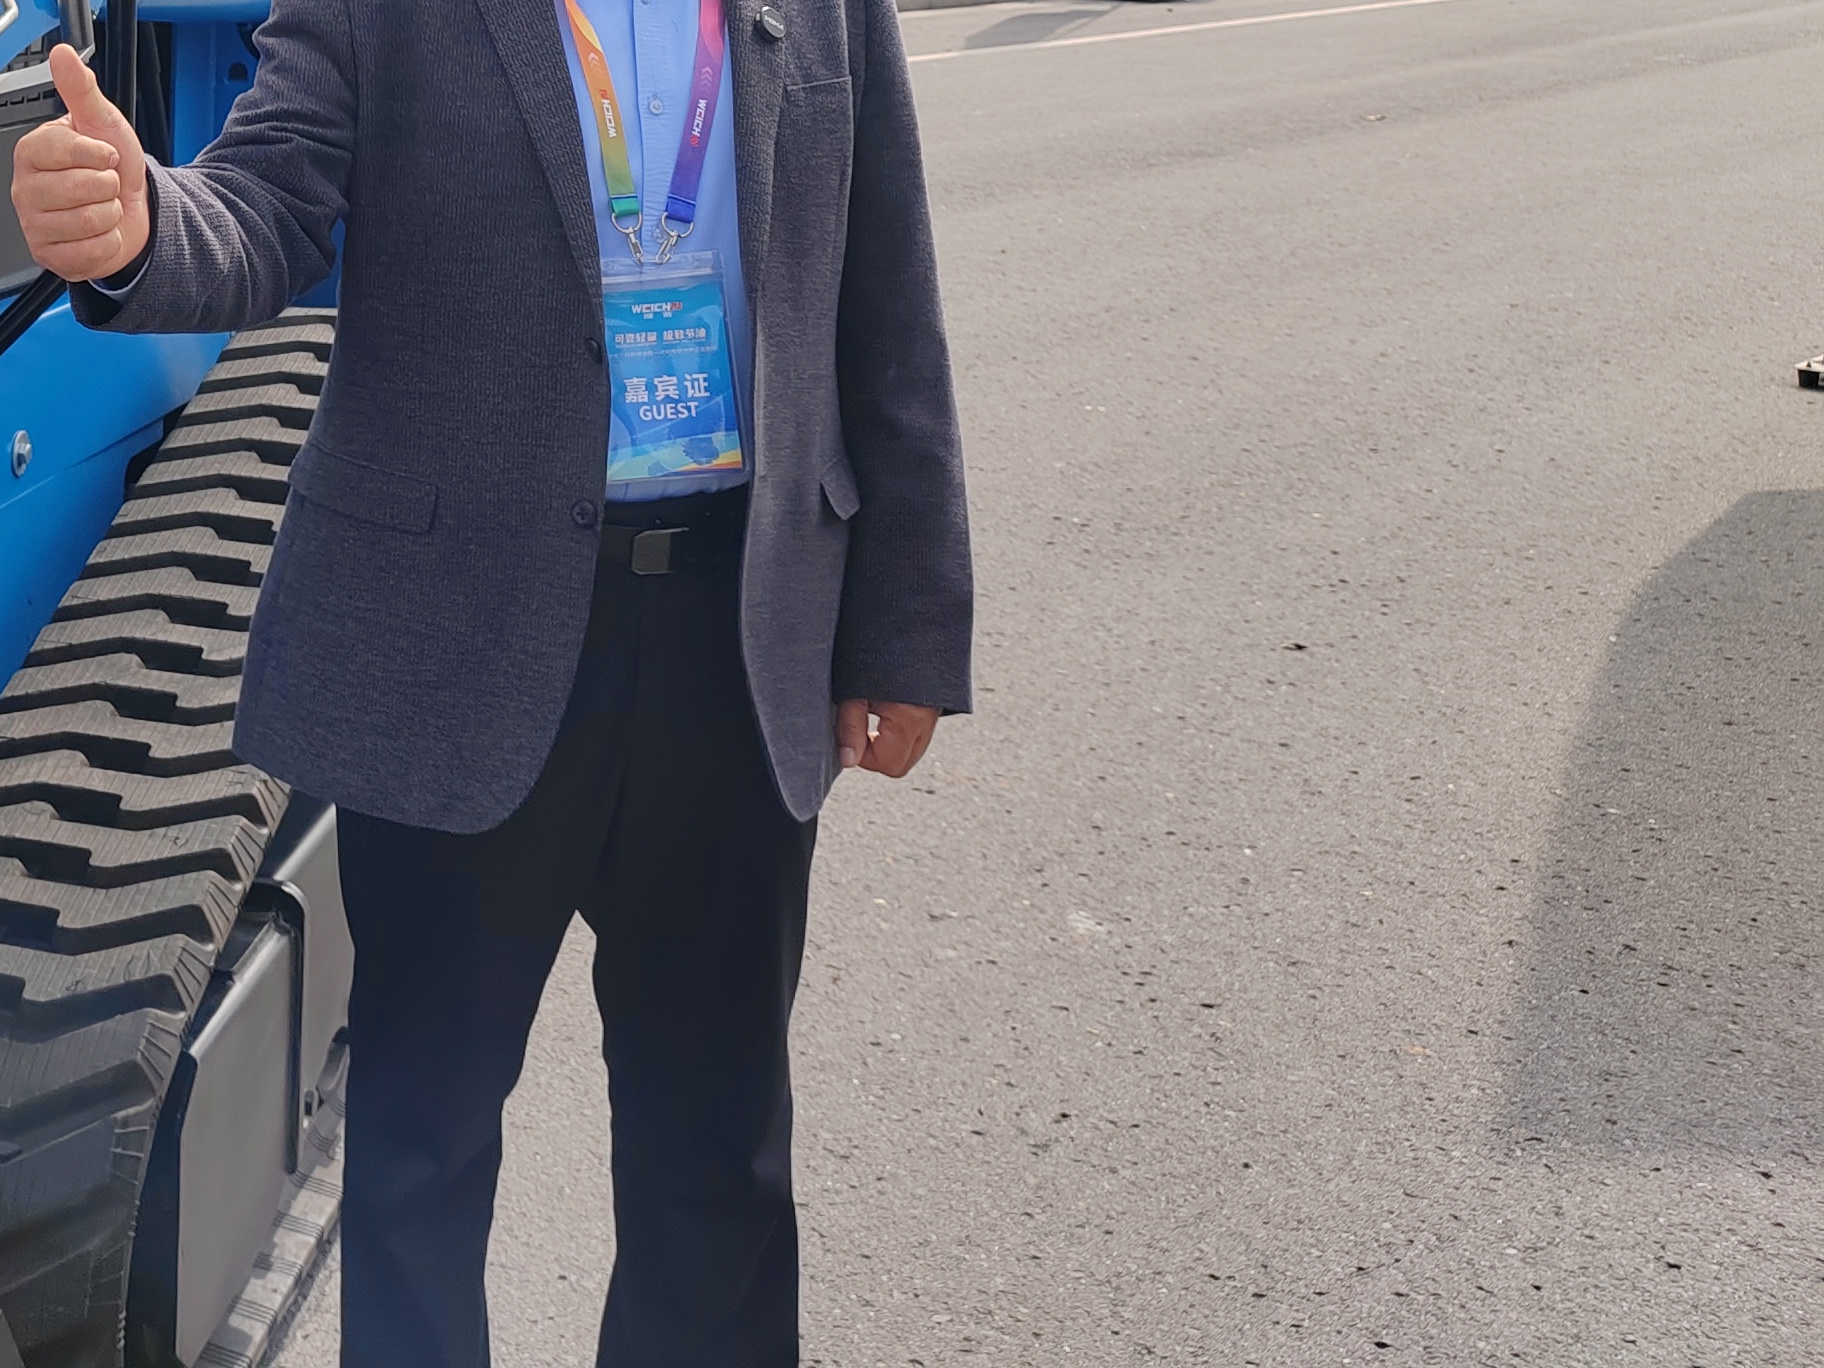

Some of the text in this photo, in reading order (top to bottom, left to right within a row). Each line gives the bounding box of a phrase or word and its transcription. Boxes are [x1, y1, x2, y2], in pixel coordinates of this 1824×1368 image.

[623, 373, 711, 403] 嘉宾证
[639, 401, 699, 421] GUEST
